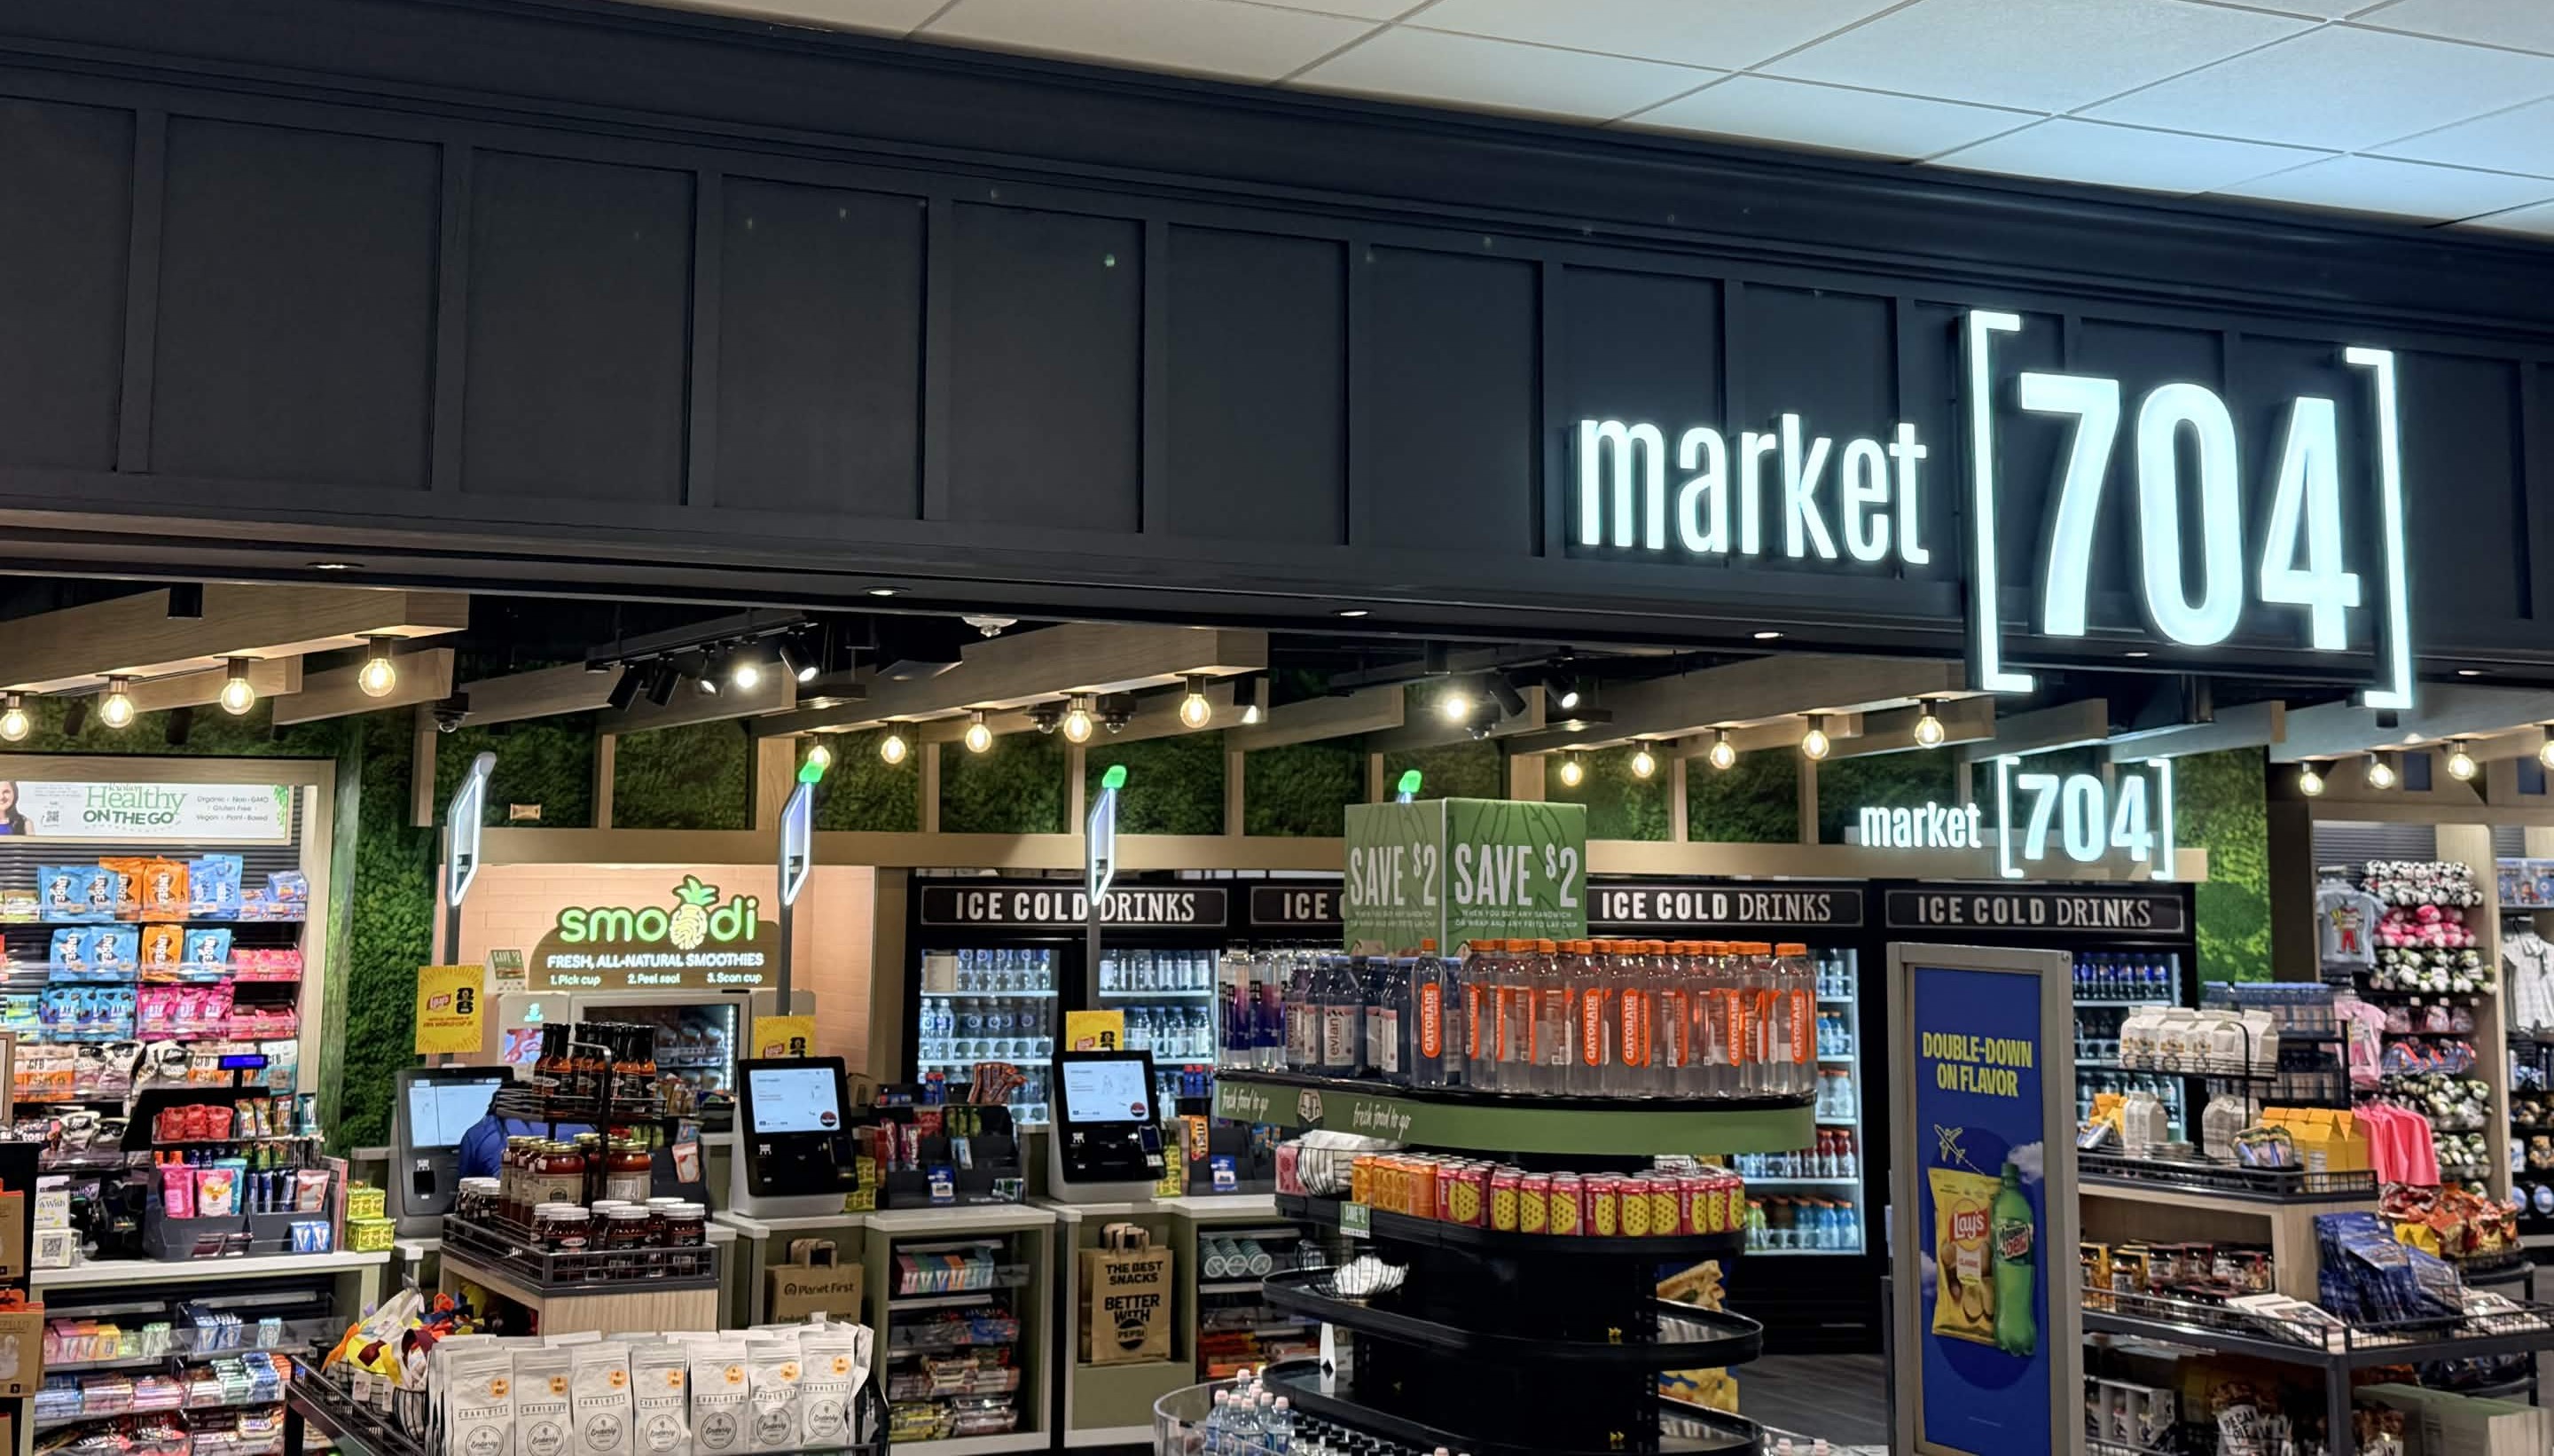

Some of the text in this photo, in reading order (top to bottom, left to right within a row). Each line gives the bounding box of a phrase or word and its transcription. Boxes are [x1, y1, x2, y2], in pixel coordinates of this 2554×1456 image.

[1580, 413, 1930, 565] market
[85, 786, 188, 817] Healthy
[82, 810, 175, 825] ON THE GO
[1860, 801, 1982, 849] market
[1350, 842, 1437, 906] SAVE $2
[1454, 842, 1578, 908] SAVE $2
[956, 892, 1195, 921] ICE COLD DRINKS
[1284, 893, 1328, 920] ICE
[1602, 891, 1831, 922] ICE COLD DRINKS
[1918, 896, 2151, 928] ICE COLD DRINKS
[547, 952, 764, 969] FRESH, ALL-NATURAL SMOOTHIES
[558, 975, 579, 985] Pick
[581, 976, 601, 987] cup
[637, 974, 658, 984] Peel
[659, 974, 680, 984] seal
[717, 973, 740, 983] Scan
[743, 974, 763, 985] cup
[1424, 990, 1435, 1052] GATORADE
[1587, 996, 1597, 1059] GATORADE
[1625, 996, 1634, 1059] GATORADE
[1328, 1017, 1340, 1056] evian
[1923, 1031, 2033, 1069] DOUBLE-DOWN
[1937, 1062, 2018, 1098] ON FLAVOR
[1221, 1087, 1236, 1111] fresh
[1236, 1085, 1251, 1113] food
[1252, 1088, 1260, 1110] to
[1260, 1097, 1270, 1121] go
[1352, 1100, 1372, 1128] fresh
[1372, 1103, 1391, 1131] food
[1391, 1107, 1398, 1129] to
[1398, 1115, 1412, 1140] go
[45, 1199, 66, 1208] Wish
[1954, 1210, 1985, 1240] Lay's
[1105, 1261, 1163, 1274] THE BEST
[1109, 1272, 1158, 1286] SNACKS
[798, 1282, 854, 1295] Planet First
[1105, 1294, 1160, 1311] BETTER
[1114, 1309, 1150, 1324] WITH
[1117, 1330, 1145, 1339] PEPSI
